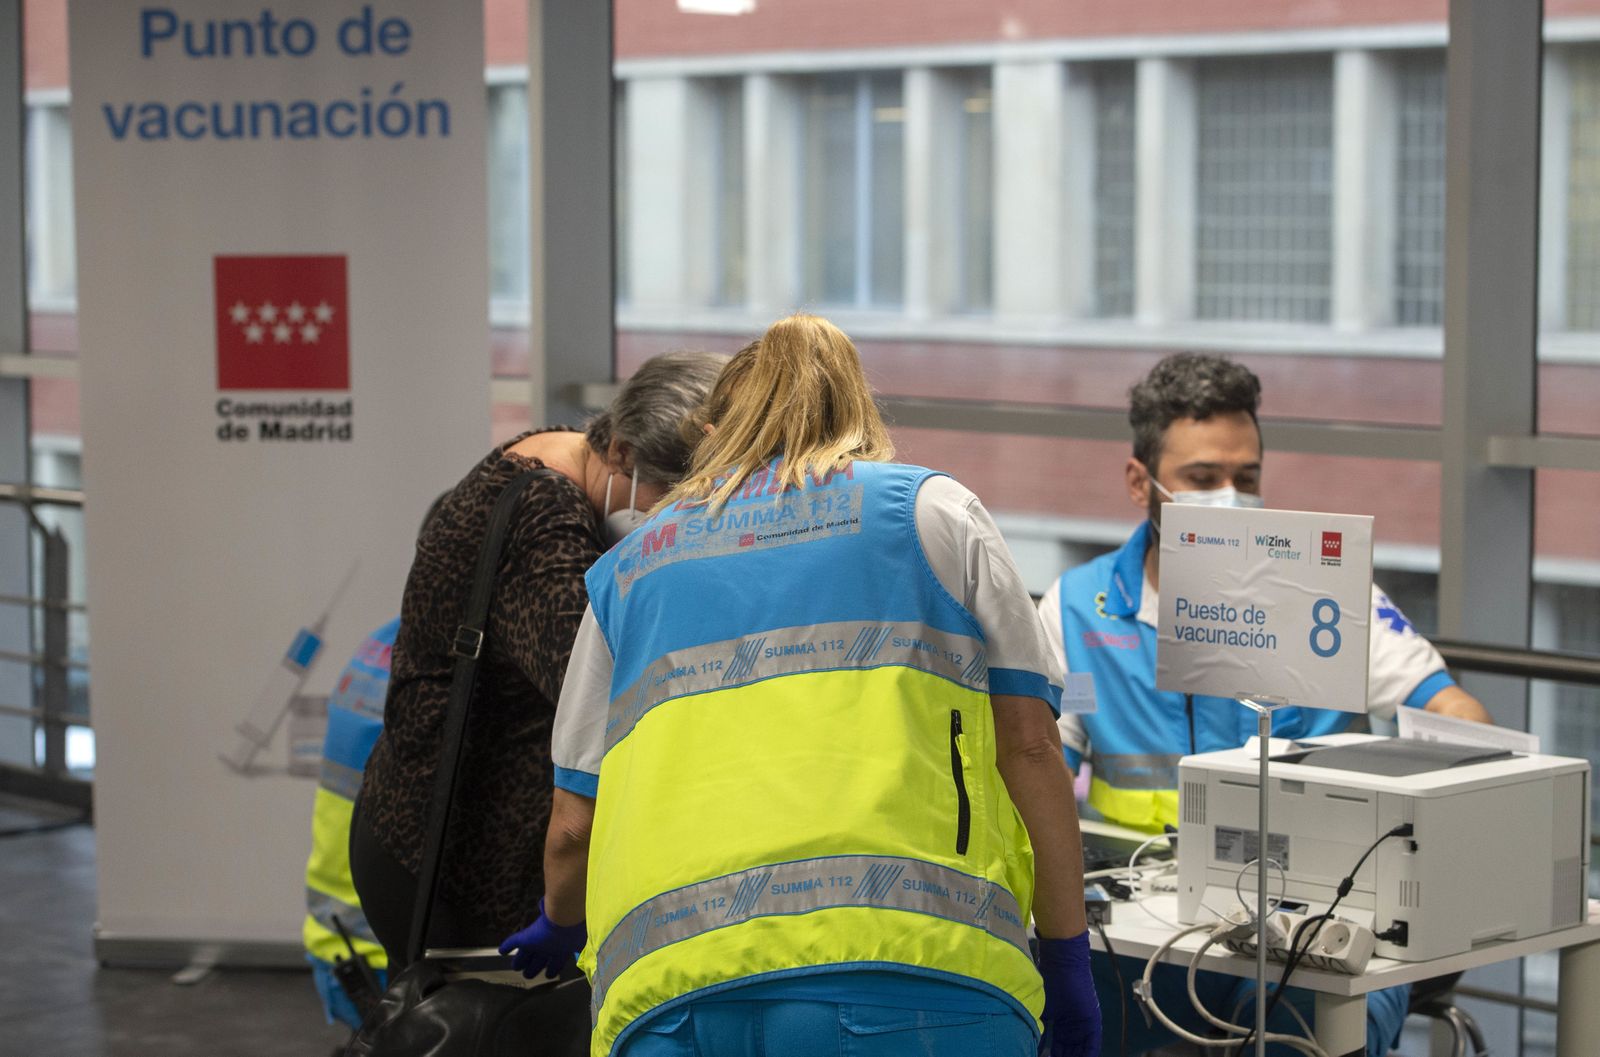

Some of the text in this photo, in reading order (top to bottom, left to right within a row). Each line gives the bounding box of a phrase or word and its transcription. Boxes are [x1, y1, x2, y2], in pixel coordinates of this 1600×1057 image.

[139, 4, 412, 59] Punto de
[103, 81, 450, 141] vacunación
[216, 398, 352, 417] Comunidad
[217, 421, 352, 441] de Madrid
[685, 504, 797, 536] SUMMA
[808, 493, 850, 517] 112
[757, 527, 809, 541] Comunidad
[826, 517, 859, 529] Madrid
[1196, 535, 1240, 547] SUMMA 112
[1255, 535, 1291, 548] WiZink
[1268, 547, 1301, 560] Center
[1175, 597, 1266, 625] Puesto de
[1174, 624, 1277, 650] vacunación
[1309, 597, 1342, 658] 8
[764, 639, 845, 659] SUMMA 112
[892, 636, 963, 666] SUMMA 112
[654, 660, 723, 686] SUMMA 112
[771, 876, 853, 896] SUMMA 112
[902, 878, 977, 905] SUMMA 112
[655, 897, 726, 928] SUMMA 112
